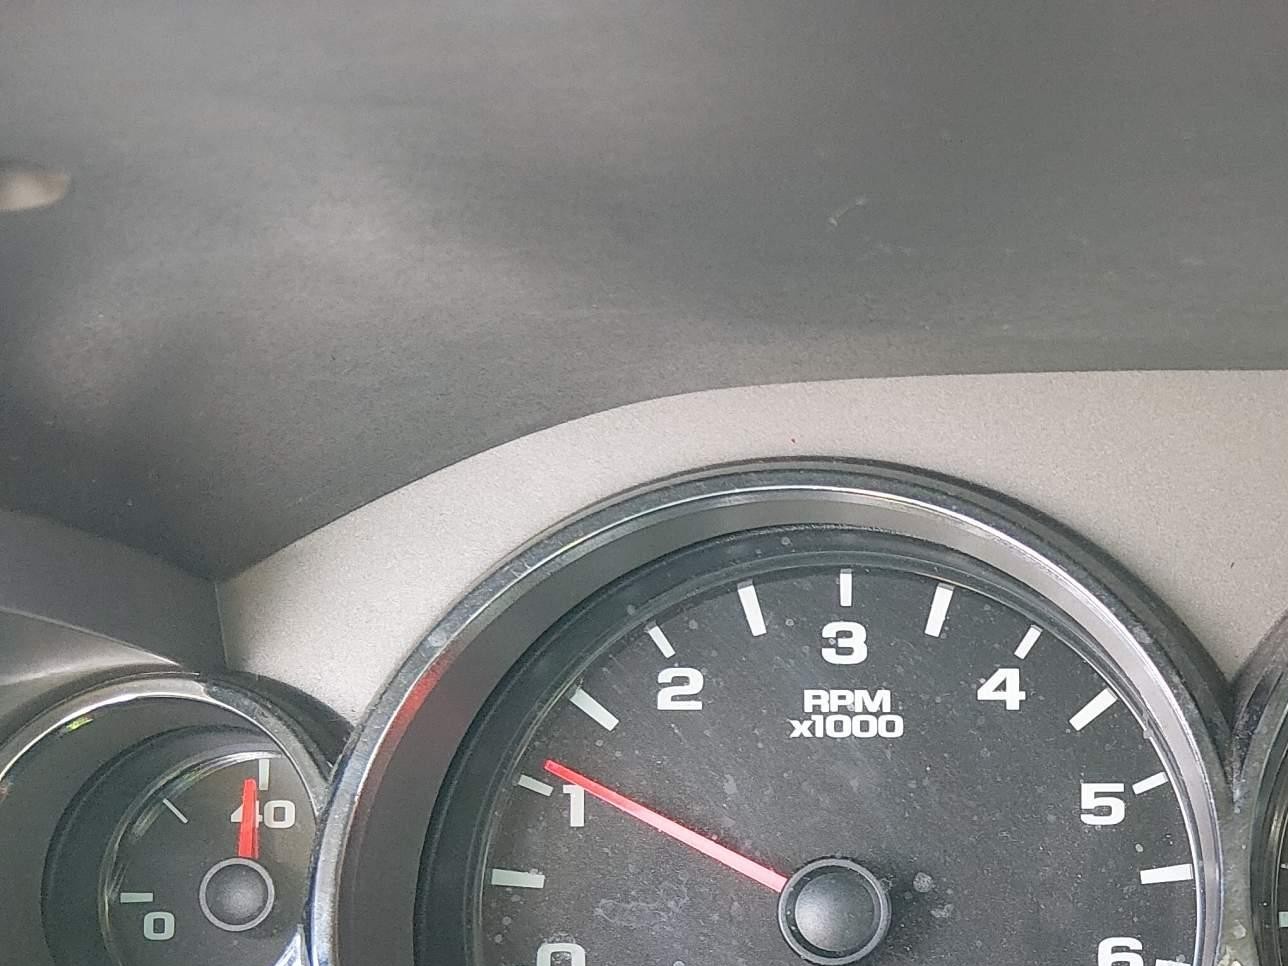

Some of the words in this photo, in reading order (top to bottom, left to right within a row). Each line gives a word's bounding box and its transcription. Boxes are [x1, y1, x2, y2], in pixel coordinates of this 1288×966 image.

[821, 620, 868, 665] 3
[656, 667, 704, 711] 2
[803, 689, 891, 713] RPM
[977, 668, 1026, 711] 4
[788, 714, 904, 739] x1000
[562, 782, 586, 827] 1
[1080, 782, 1126, 826] 5
[143, 911, 175, 941] 0
